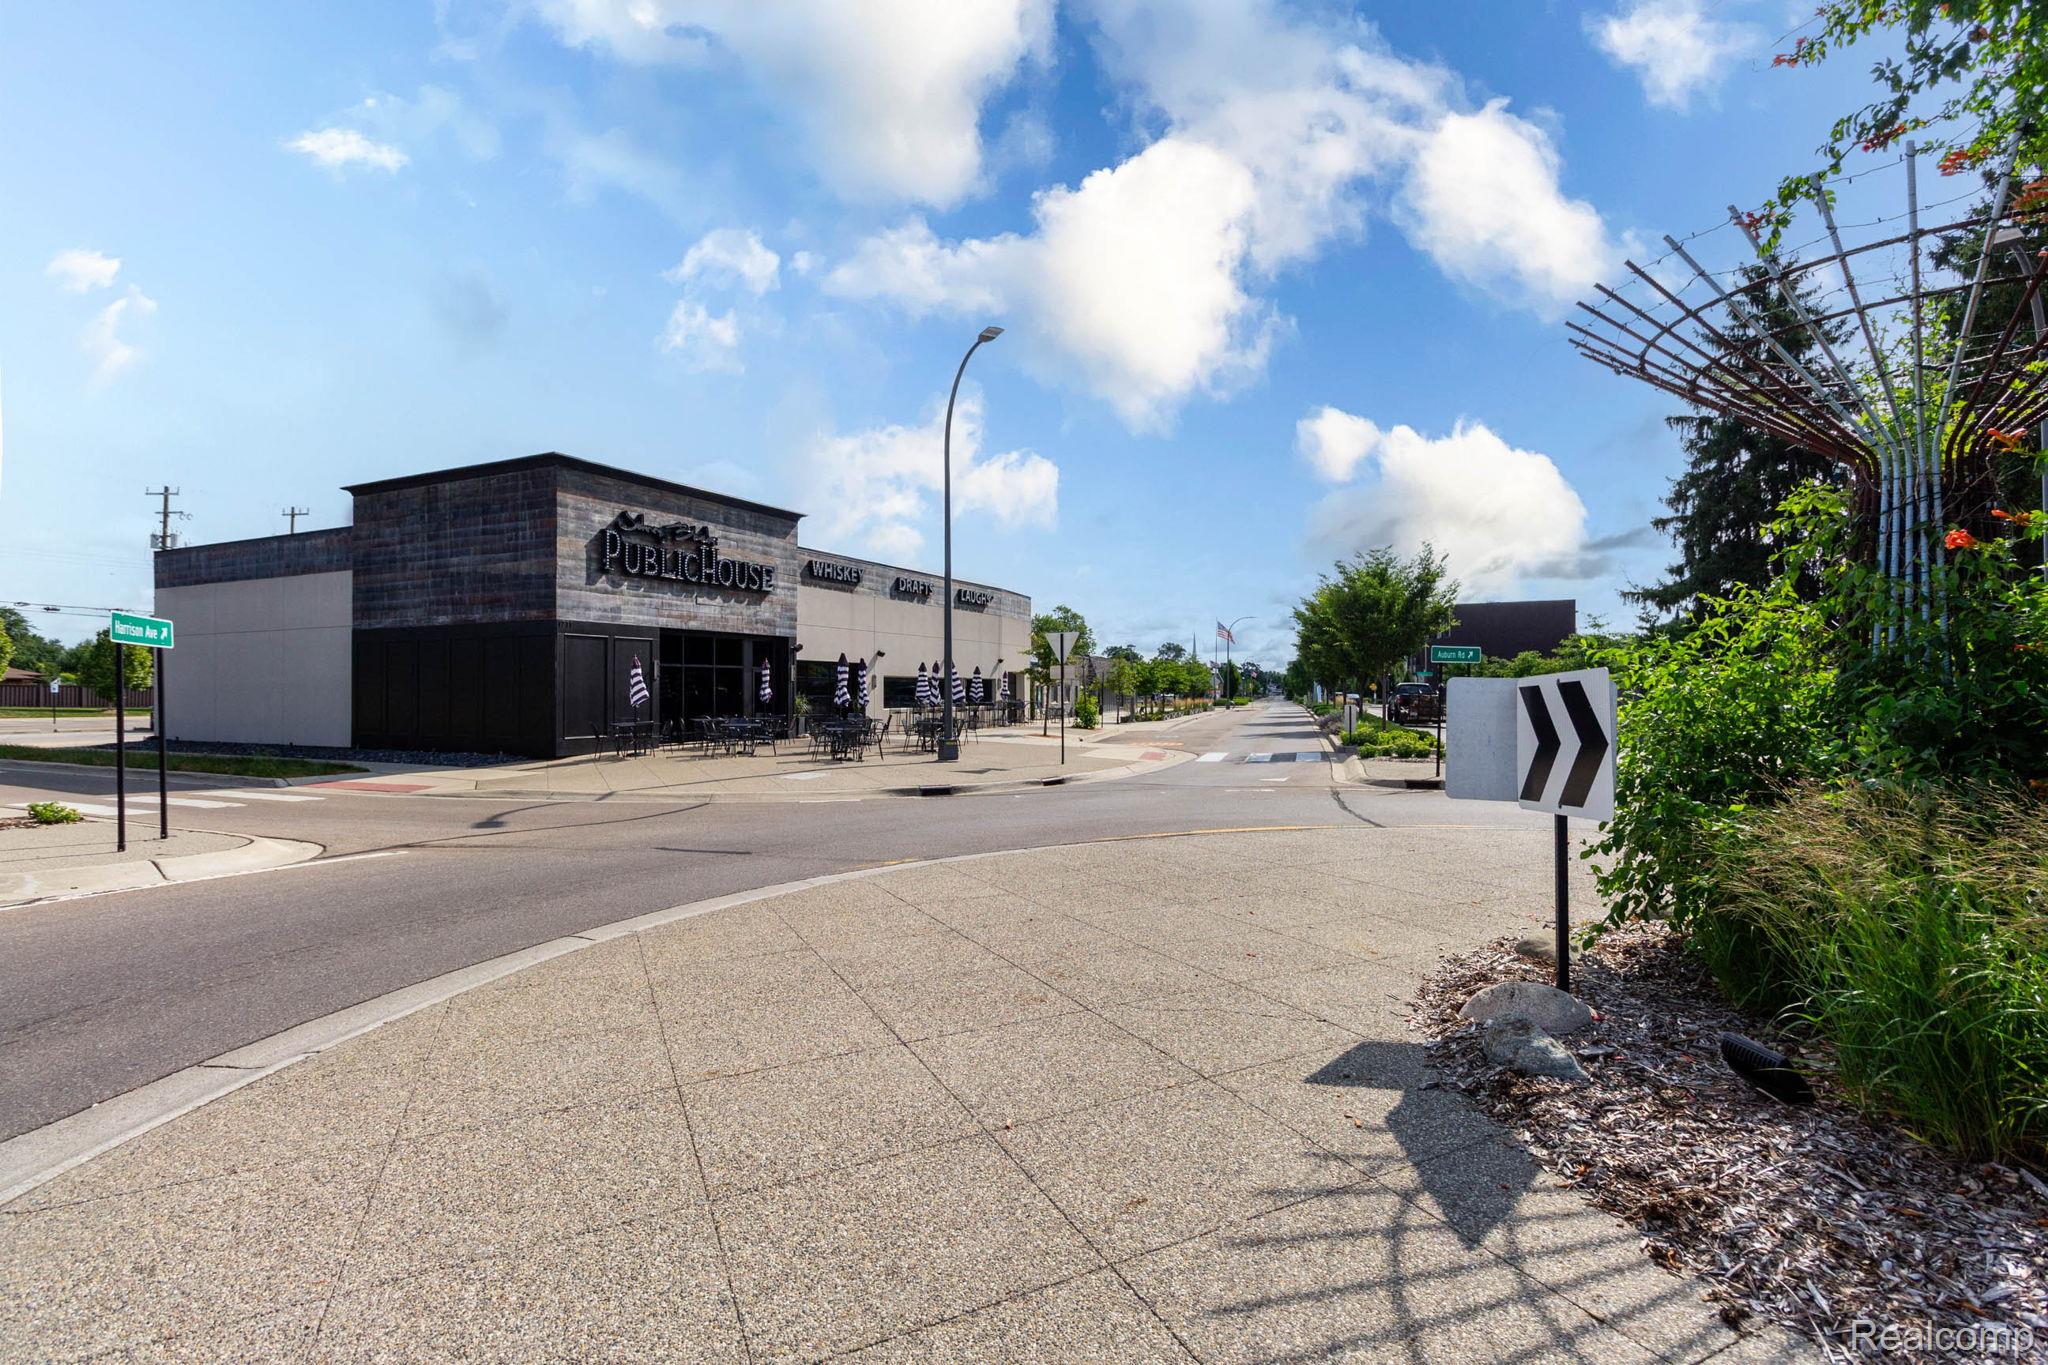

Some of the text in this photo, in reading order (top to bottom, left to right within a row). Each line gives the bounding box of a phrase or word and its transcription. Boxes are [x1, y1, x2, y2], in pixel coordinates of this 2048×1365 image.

[700, 544, 775, 592] HOUSE
[812, 560, 865, 583] WHISKEY
[899, 578, 935, 595] DRAFTS
[115, 620, 158, 639] Harrison Ave
[1438, 650, 1466, 659] Auburn Rd
